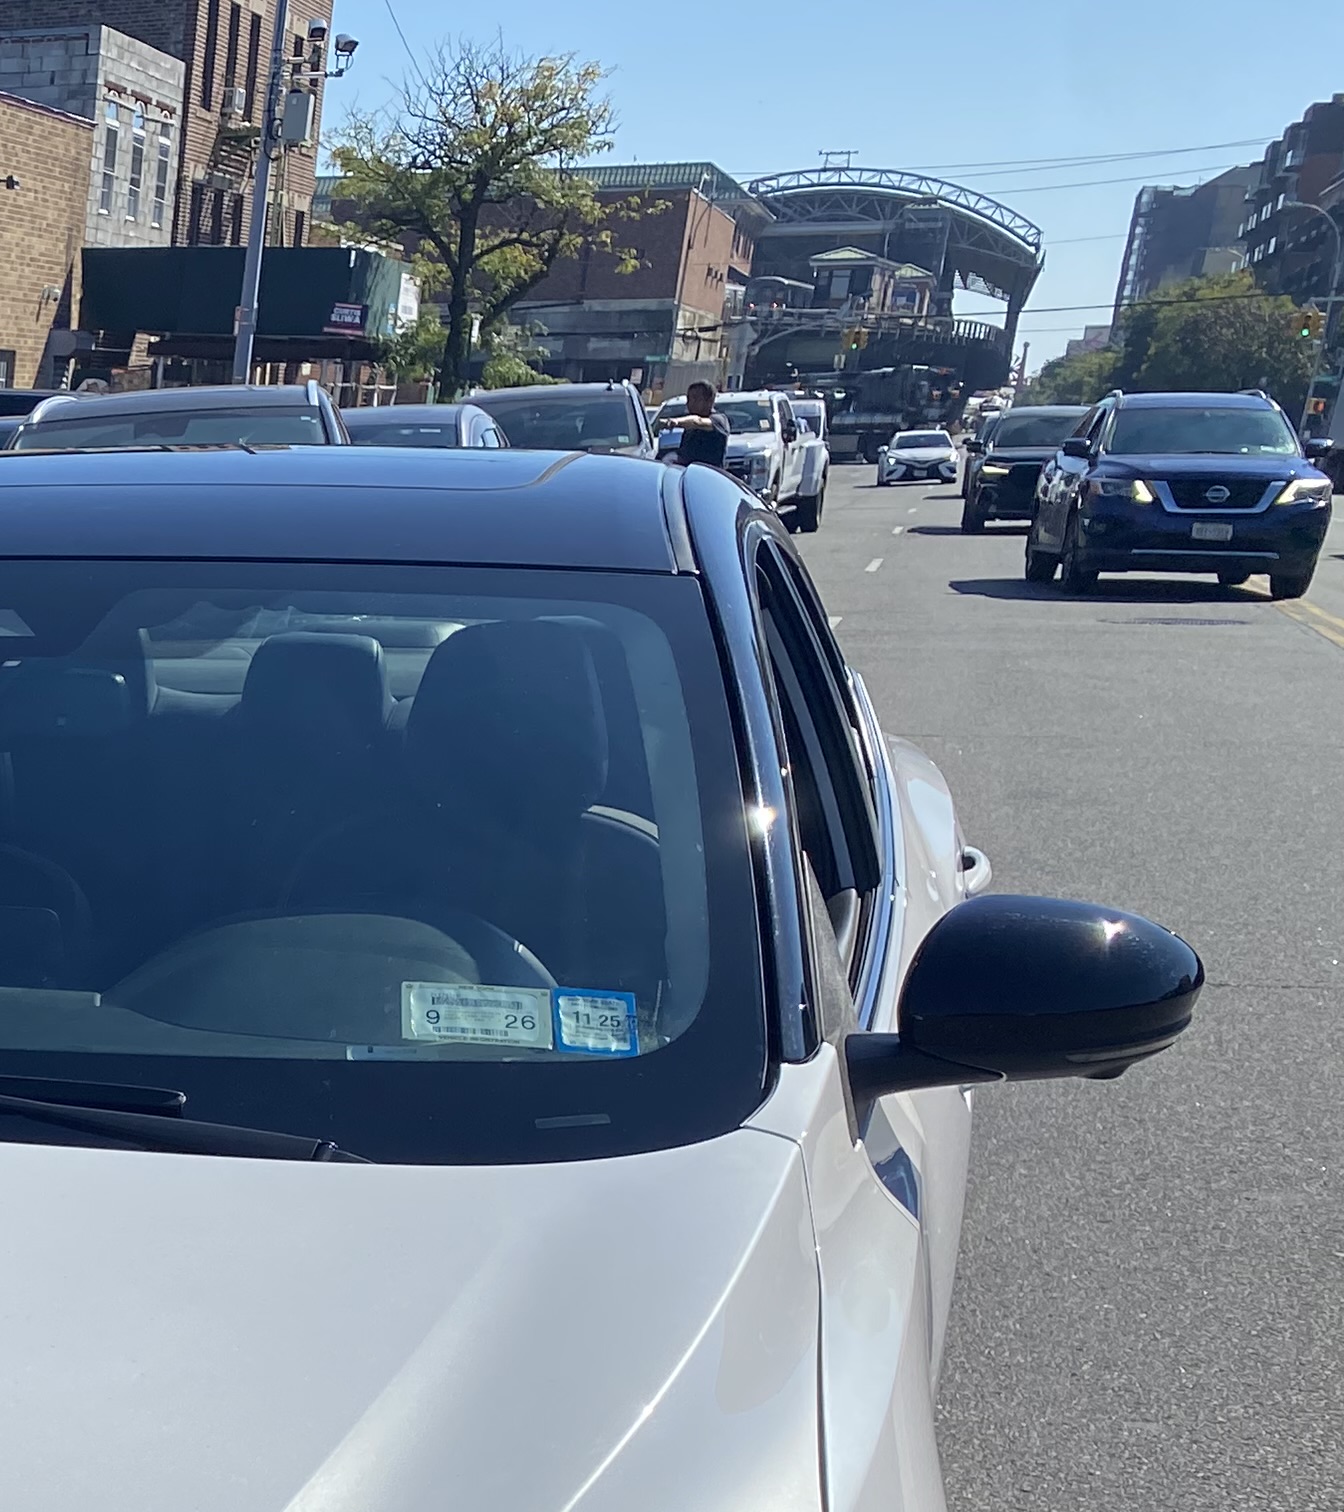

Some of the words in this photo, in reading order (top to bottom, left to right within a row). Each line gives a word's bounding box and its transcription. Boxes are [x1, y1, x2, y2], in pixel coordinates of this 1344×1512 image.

[425, 1009, 440, 1025] 9
[504, 1014, 536, 1031] 26
[572, 1010, 591, 1025] 11
[598, 1014, 621, 1029] 25
